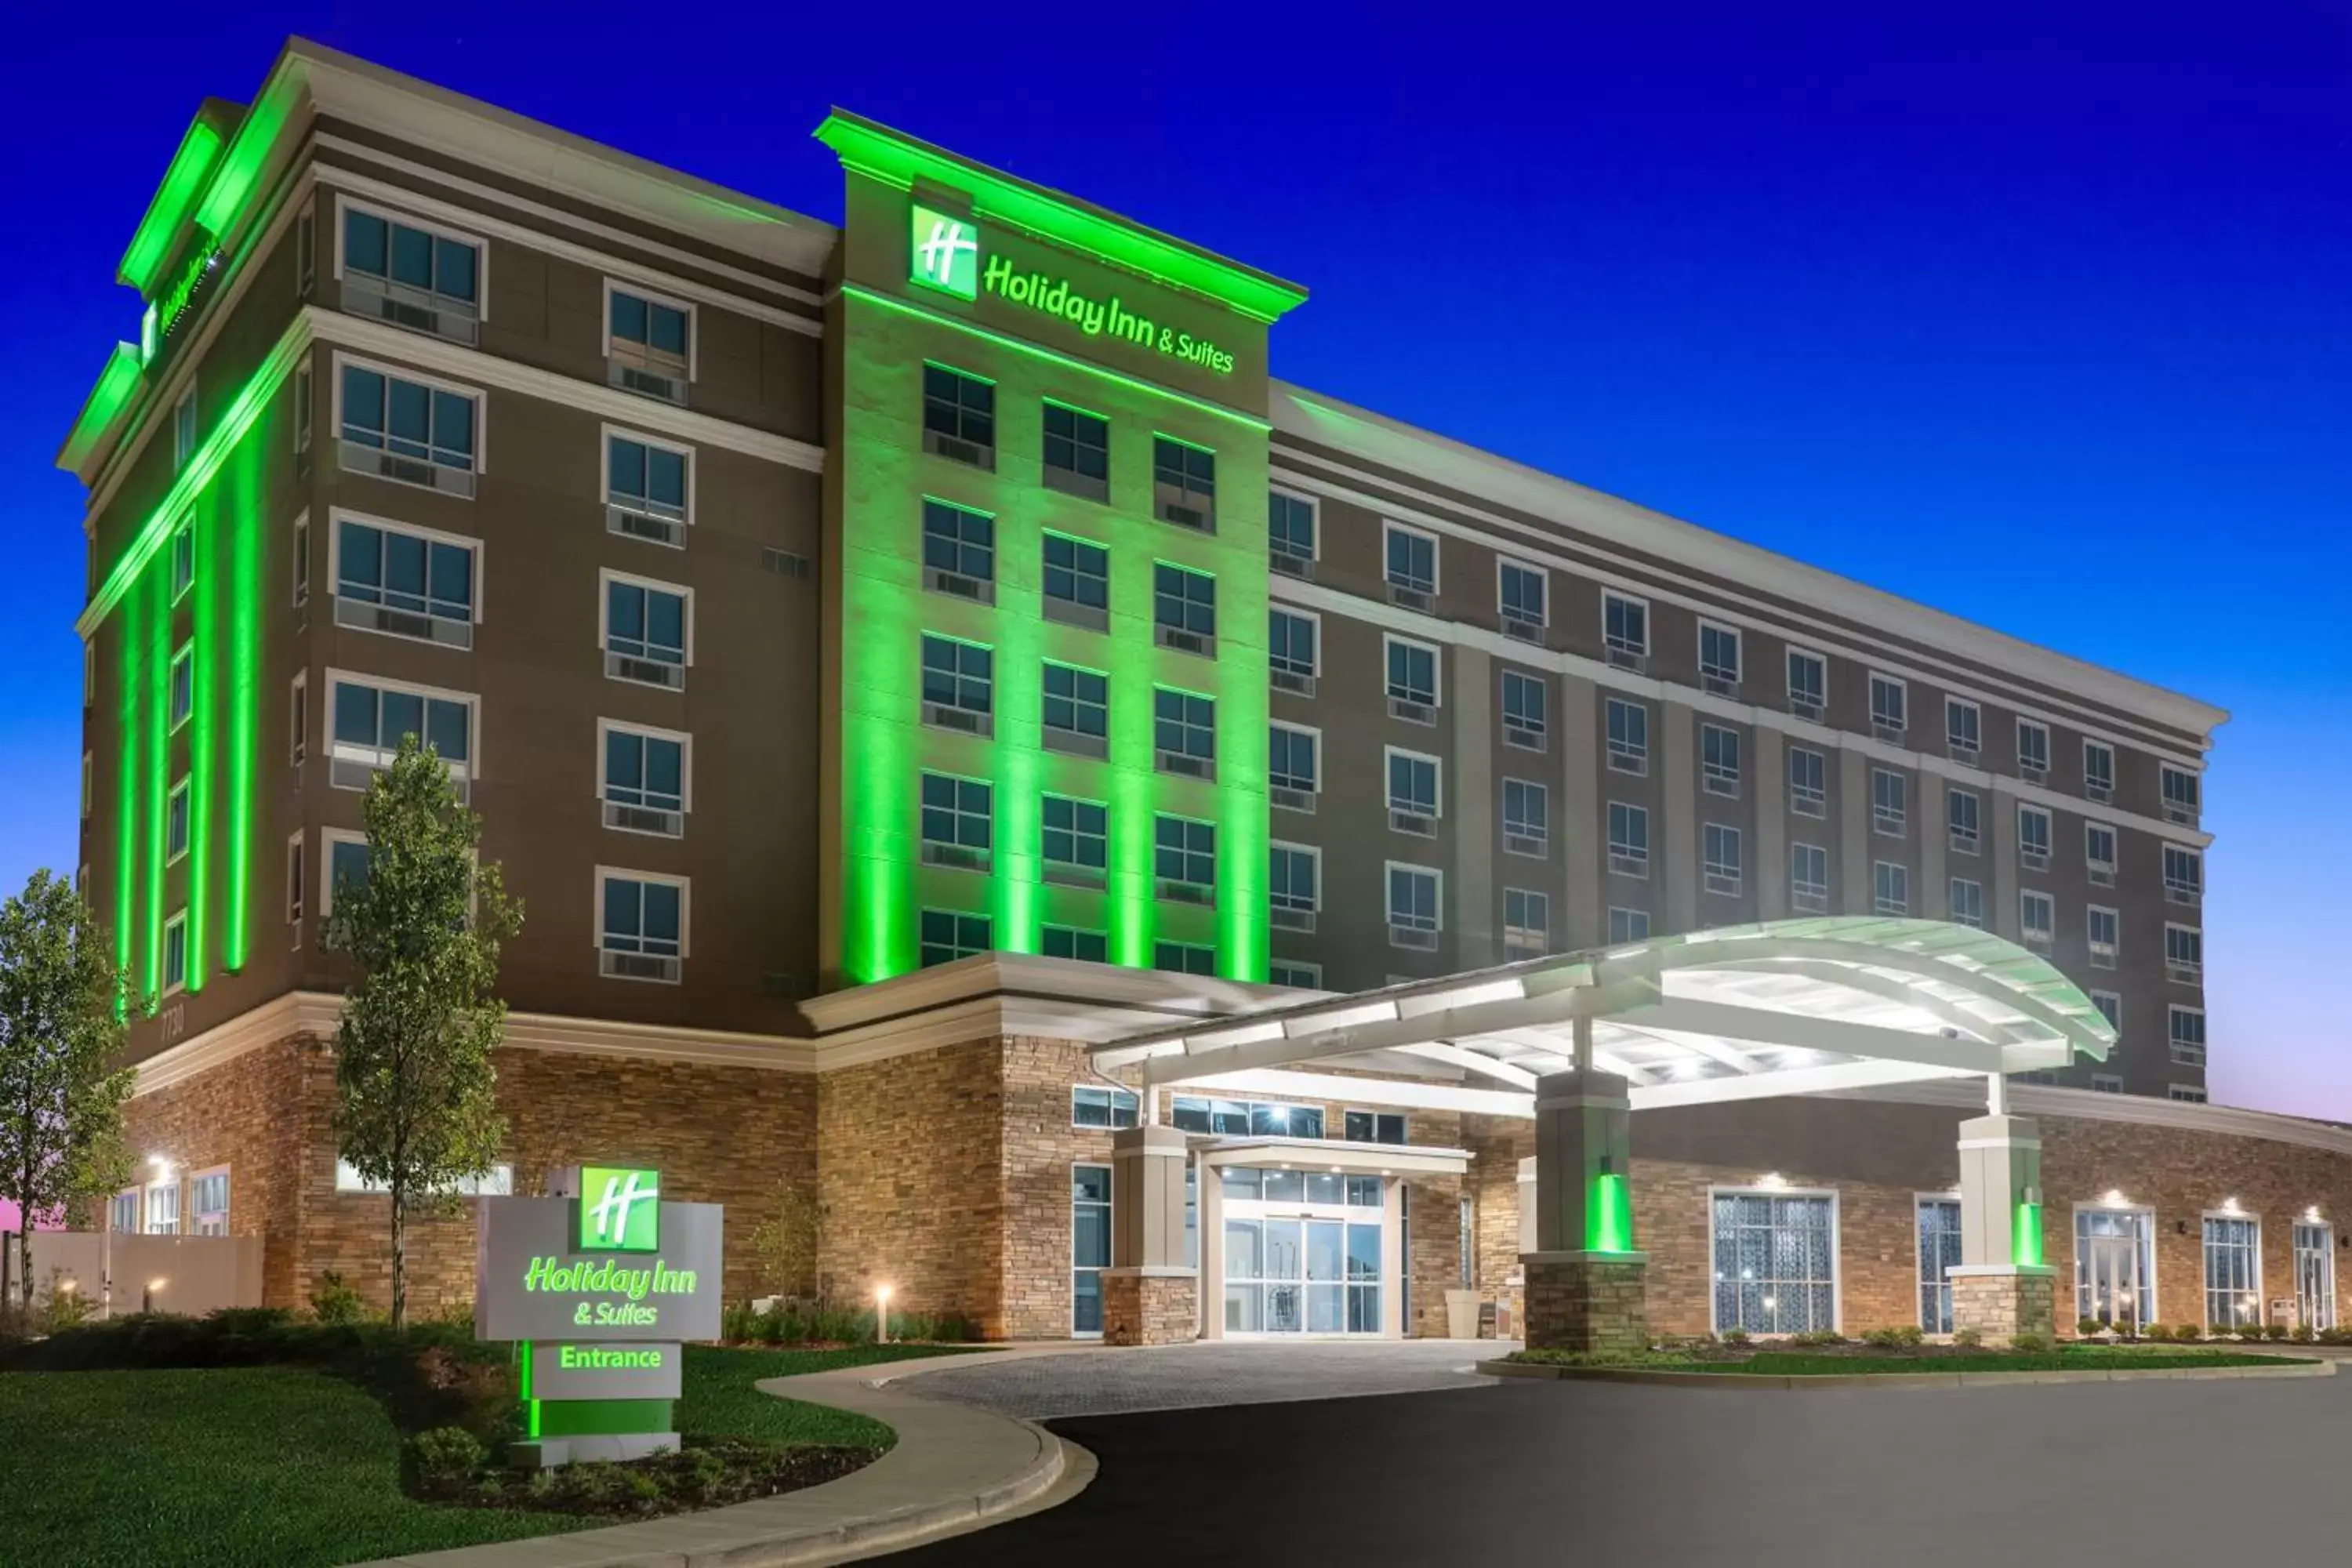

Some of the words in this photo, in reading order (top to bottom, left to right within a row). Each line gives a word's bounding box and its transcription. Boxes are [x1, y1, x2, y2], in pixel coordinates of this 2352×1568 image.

[984, 253, 1105, 335] Holiday
[1108, 297, 1154, 347] Inn
[1159, 328, 1174, 354] &
[1177, 333, 1234, 373] Suites
[524, 1256, 651, 1300] Holiday
[652, 1259, 697, 1293] Inn
[574, 1301, 592, 1325] &
[594, 1302, 658, 1325] Suites
[560, 1345, 662, 1368] Entrance
